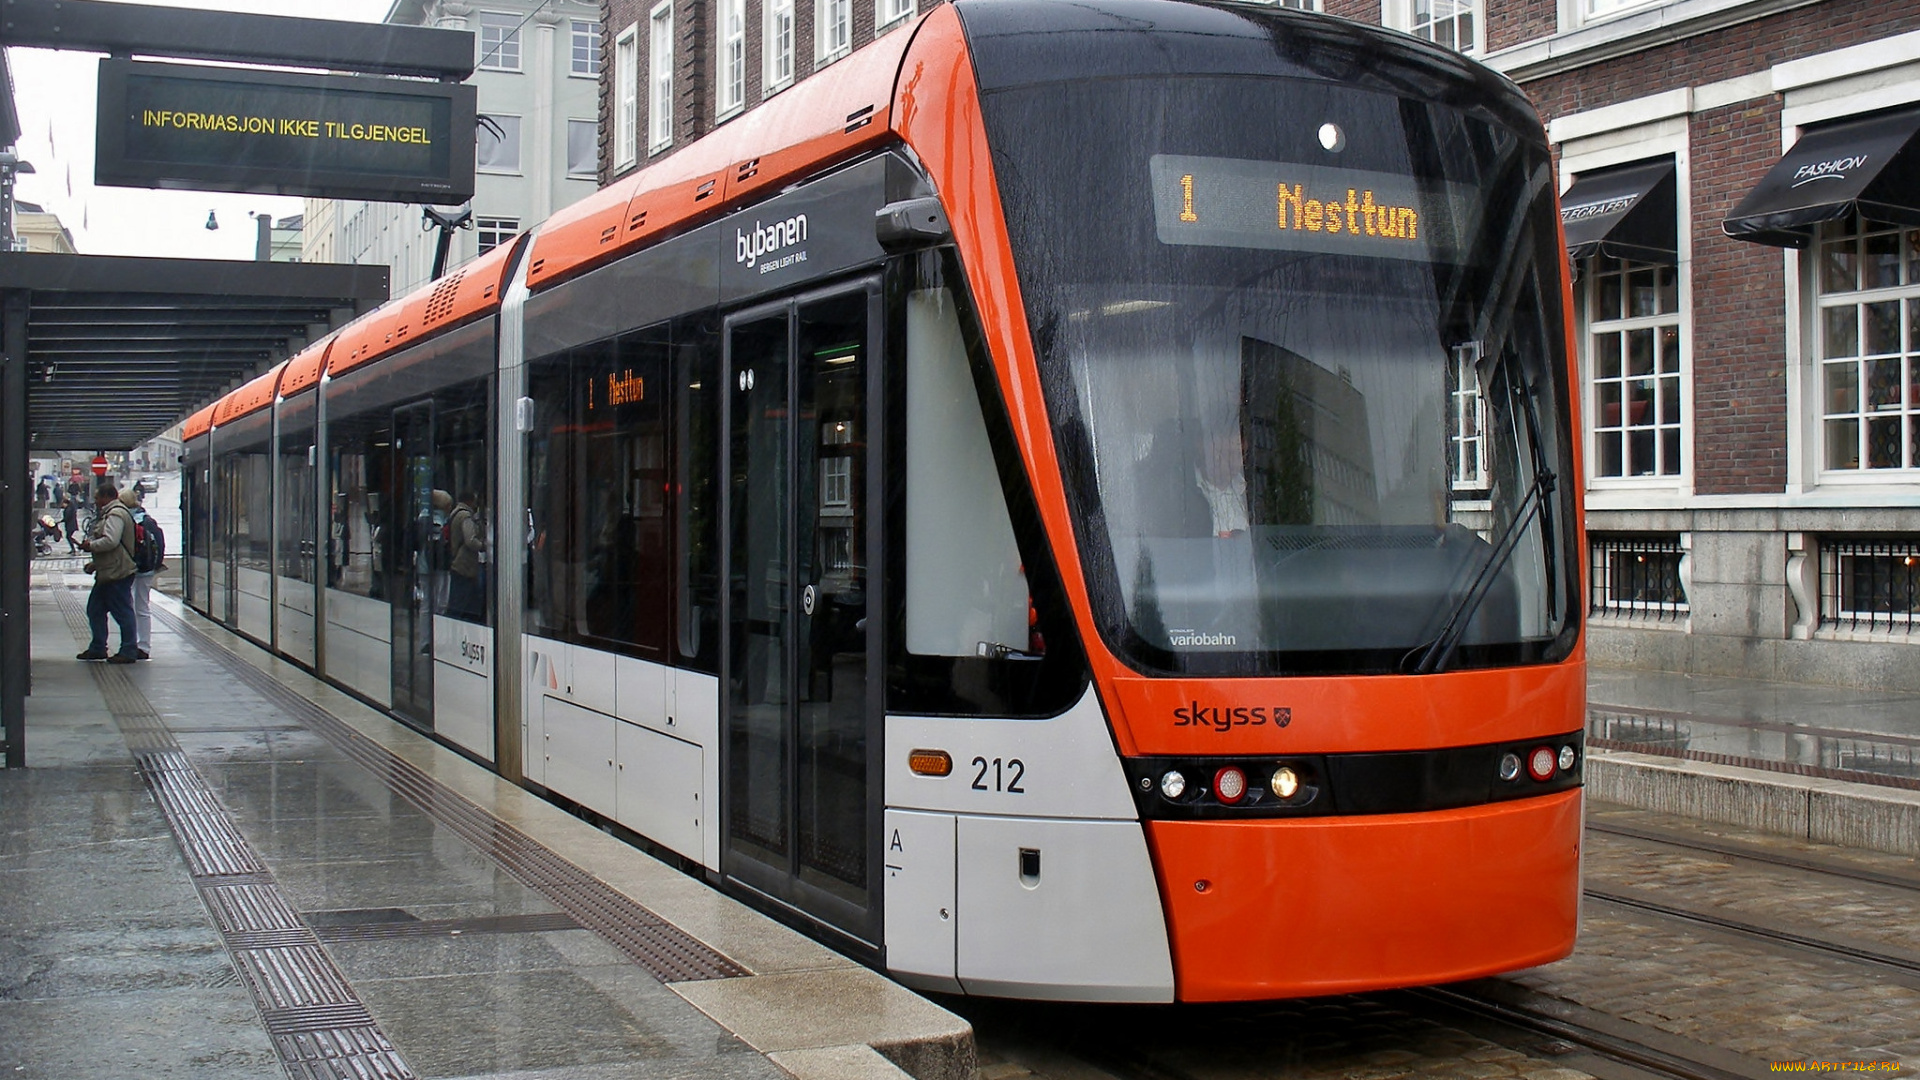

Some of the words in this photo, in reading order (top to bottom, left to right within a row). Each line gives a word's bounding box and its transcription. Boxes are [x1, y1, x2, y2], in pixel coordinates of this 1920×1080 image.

[143, 110, 275, 134] INFORMASJON
[279, 118, 319, 137] IKKE
[325, 122, 431, 144] TILGJENGEL
[1794, 155, 1867, 179] FASHION
[1179, 173, 1199, 223] 1
[1277, 182, 1418, 240] Nesttun
[736, 213, 808, 268] bybanen
[759, 261, 780, 275] BERGEN
[780, 254, 795, 268] LIGHT
[795, 251, 807, 264] RAIL
[609, 369, 643, 406] Nesttun
[461, 635, 480, 665] skyss
[1169, 632, 1236, 646] variobahn
[1173, 700, 1267, 732] skyss
[971, 756, 1025, 794] 212
[890, 828, 903, 852] A
